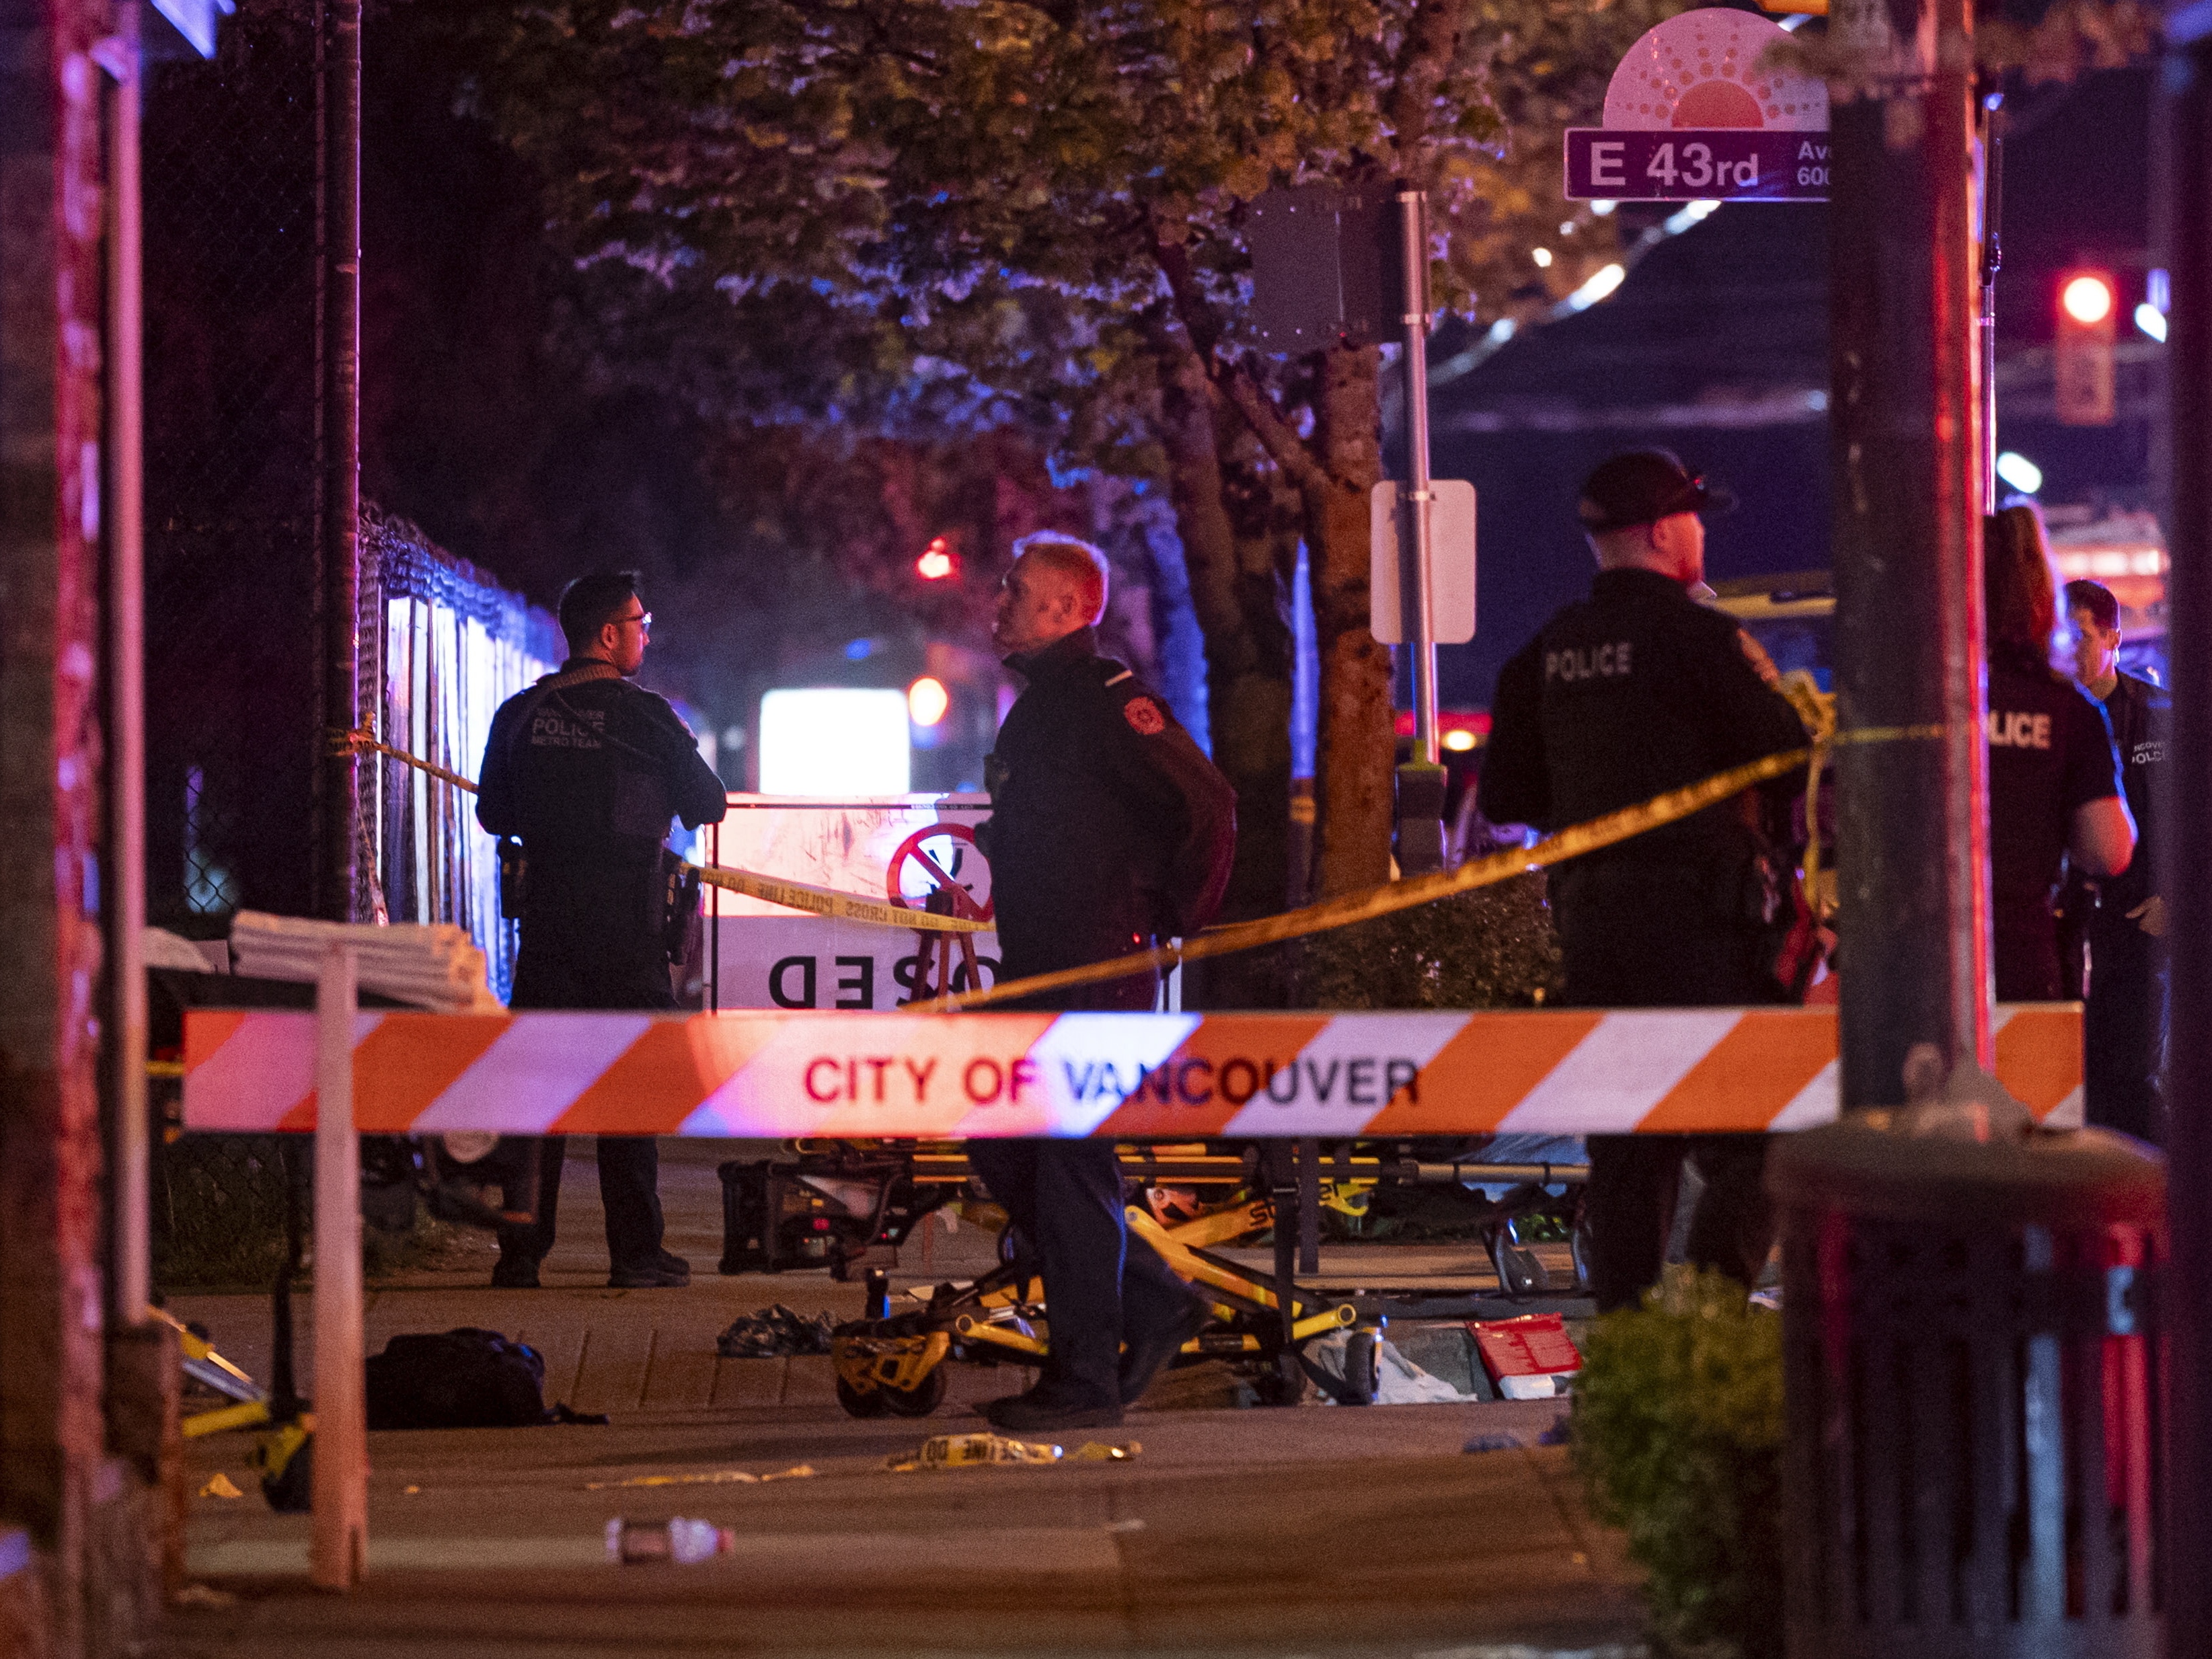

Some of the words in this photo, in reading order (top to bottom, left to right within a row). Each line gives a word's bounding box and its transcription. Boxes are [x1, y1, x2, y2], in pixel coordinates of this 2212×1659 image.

[1591, 142, 1626, 186] E
[1646, 142, 1759, 187] 43rd
[1545, 642, 1633, 683] POLICE
[1988, 709, 2052, 750] LICE
[804, 1056, 938, 1104] CITY
[964, 1056, 1036, 1104] OF
[1064, 1056, 1420, 1106] VANCOUVER
